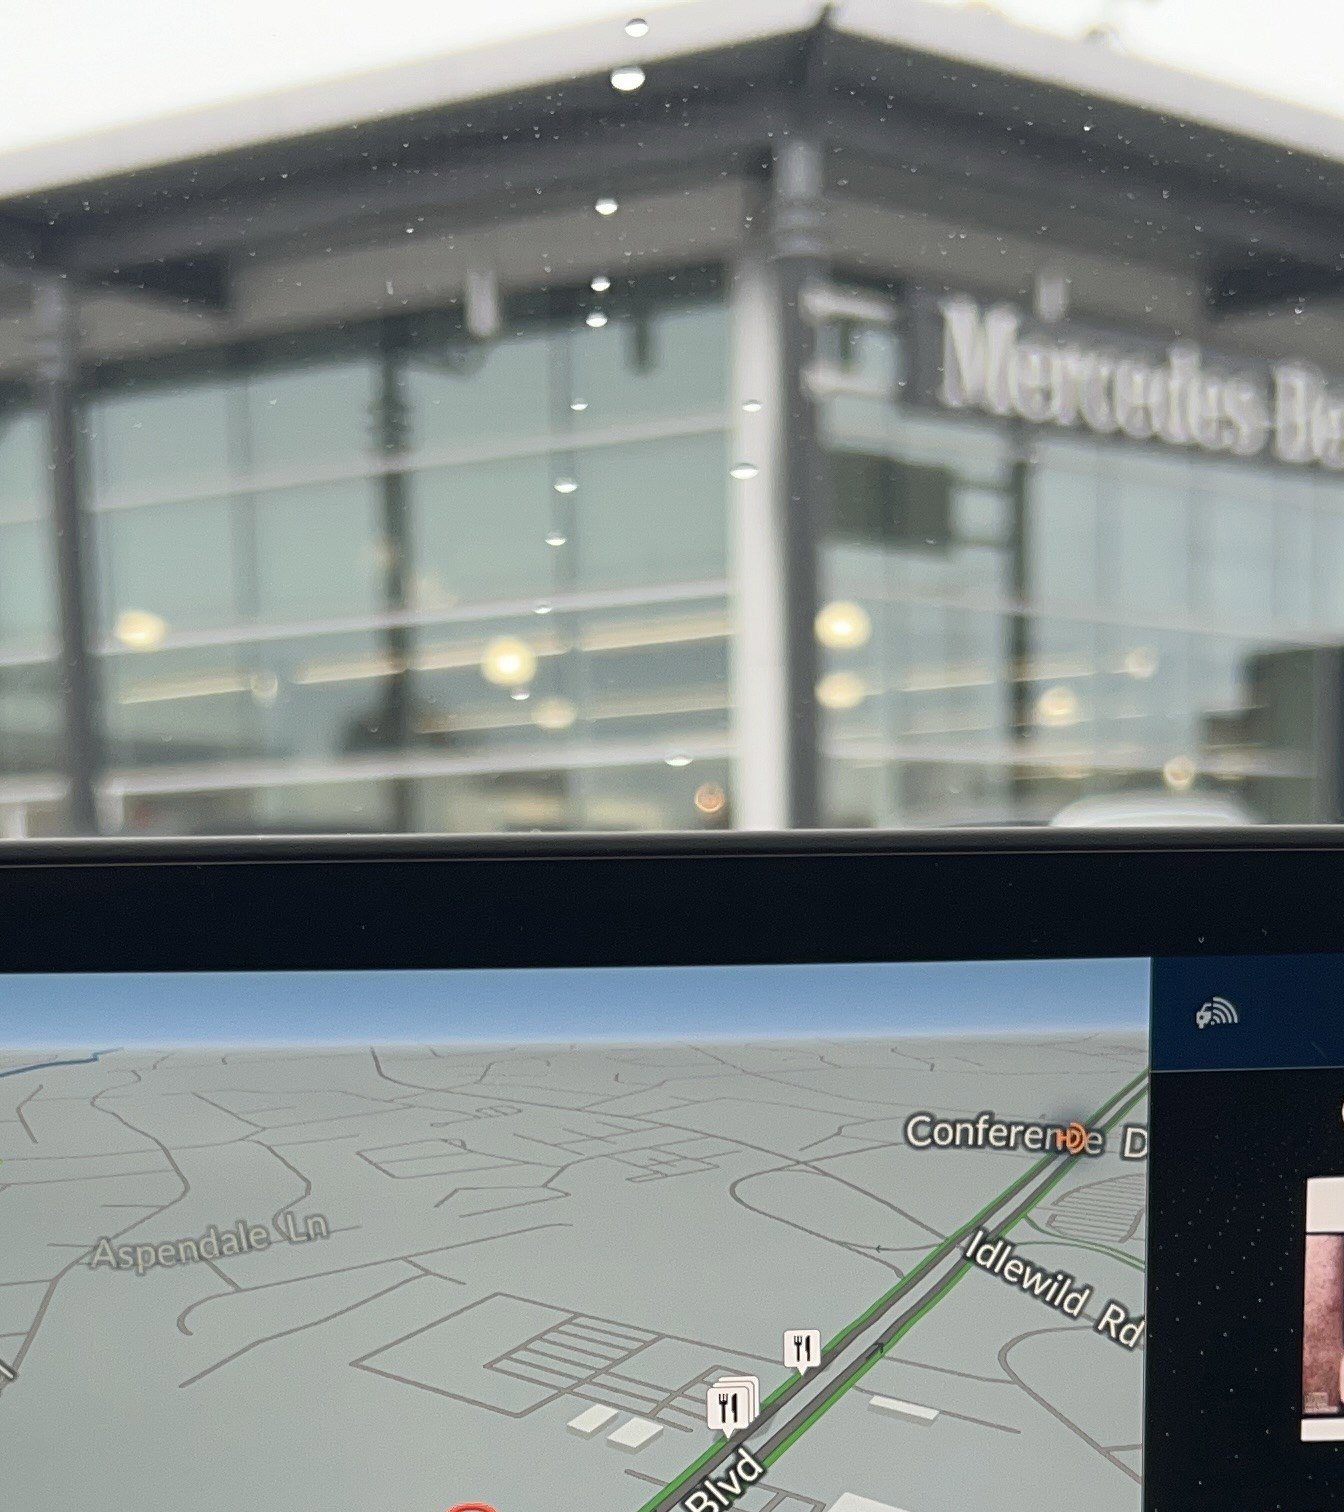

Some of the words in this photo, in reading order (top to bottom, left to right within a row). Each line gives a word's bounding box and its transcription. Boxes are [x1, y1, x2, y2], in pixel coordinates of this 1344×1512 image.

[905, 1113, 1103, 1155] Conferene
[91, 1218, 270, 1274] Aspendale
[286, 1213, 330, 1243] Ln
[966, 1230, 1091, 1317] Idlewild
[1098, 1302, 1146, 1349] Rd
